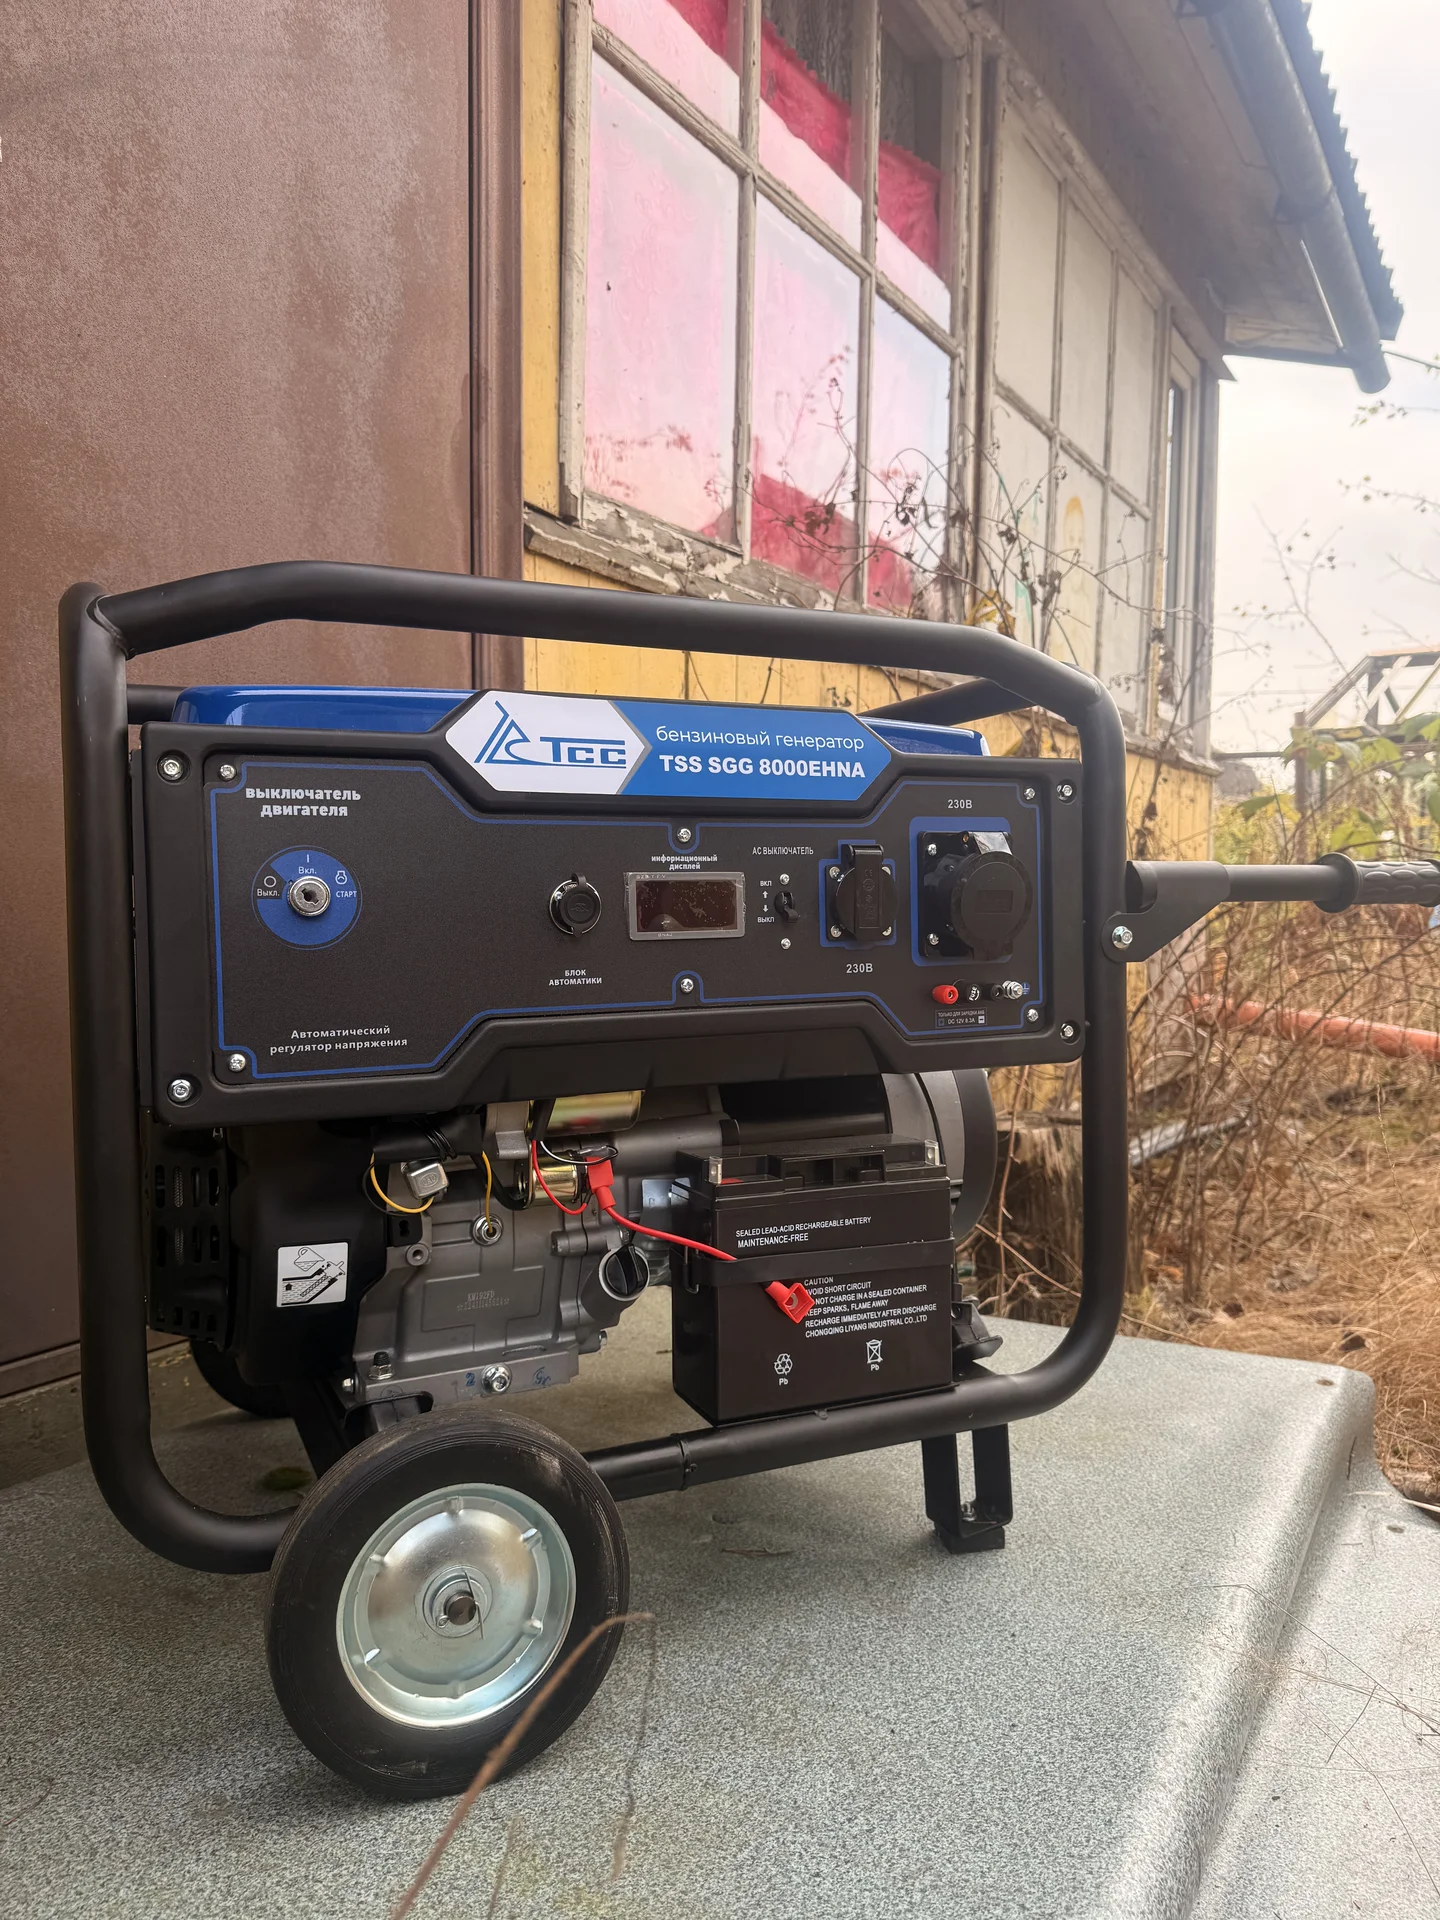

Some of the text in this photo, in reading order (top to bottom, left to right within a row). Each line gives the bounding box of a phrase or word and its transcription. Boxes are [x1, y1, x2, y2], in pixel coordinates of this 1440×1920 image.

[655, 725, 865, 754] бензиновый генератор
[659, 753, 866, 778] TSS SGG 8000EHNA
[260, 803, 348, 817] двигателя
[763, 846, 814, 856] ВЫКЛЮЧАТЕЛЬ
[651, 854, 718, 863] информационный
[298, 866, 317, 875] Вкл.
[669, 862, 701, 871] дисплей
[256, 888, 281, 898] Выкл.
[335, 890, 358, 898] СТАРТ
[757, 916, 775, 924] ВЫКЛ
[564, 968, 587, 977] БЛОК
[548, 977, 603, 987] АВТОМАТИКИ
[291, 1025, 391, 1039] Автоматический
[270, 1038, 408, 1055] регулятор напряжения
[735, 1216, 872, 1238] SEALED LEAD-ACID RECHARGEABLE BATTERY
[737, 1232, 809, 1248] MAINTENANCE-FREE
[804, 1276, 834, 1286] CAUTION
[806, 1281, 872, 1296] VOID SHORT CIRCUIT
[815, 1296, 829, 1306] NOT
[829, 1293, 856, 1304] CHARGE
[868, 1288, 892, 1300] SEALED
[892, 1284, 928, 1297] CONTAINER
[850, 1300, 872, 1312] FLAME
[871, 1298, 889, 1310] AWAY
[805, 1303, 937, 1328] RECHARGE IMMEDIATELY AFTER DISCHARGE
[805, 1326, 844, 1339] CHONGQING
[844, 1322, 868, 1335] LIYANG
[867, 1317, 904, 1331] INDUSTRIAL
[870, 1363, 880, 1371] Pb
[778, 1377, 789, 1386] Pb
